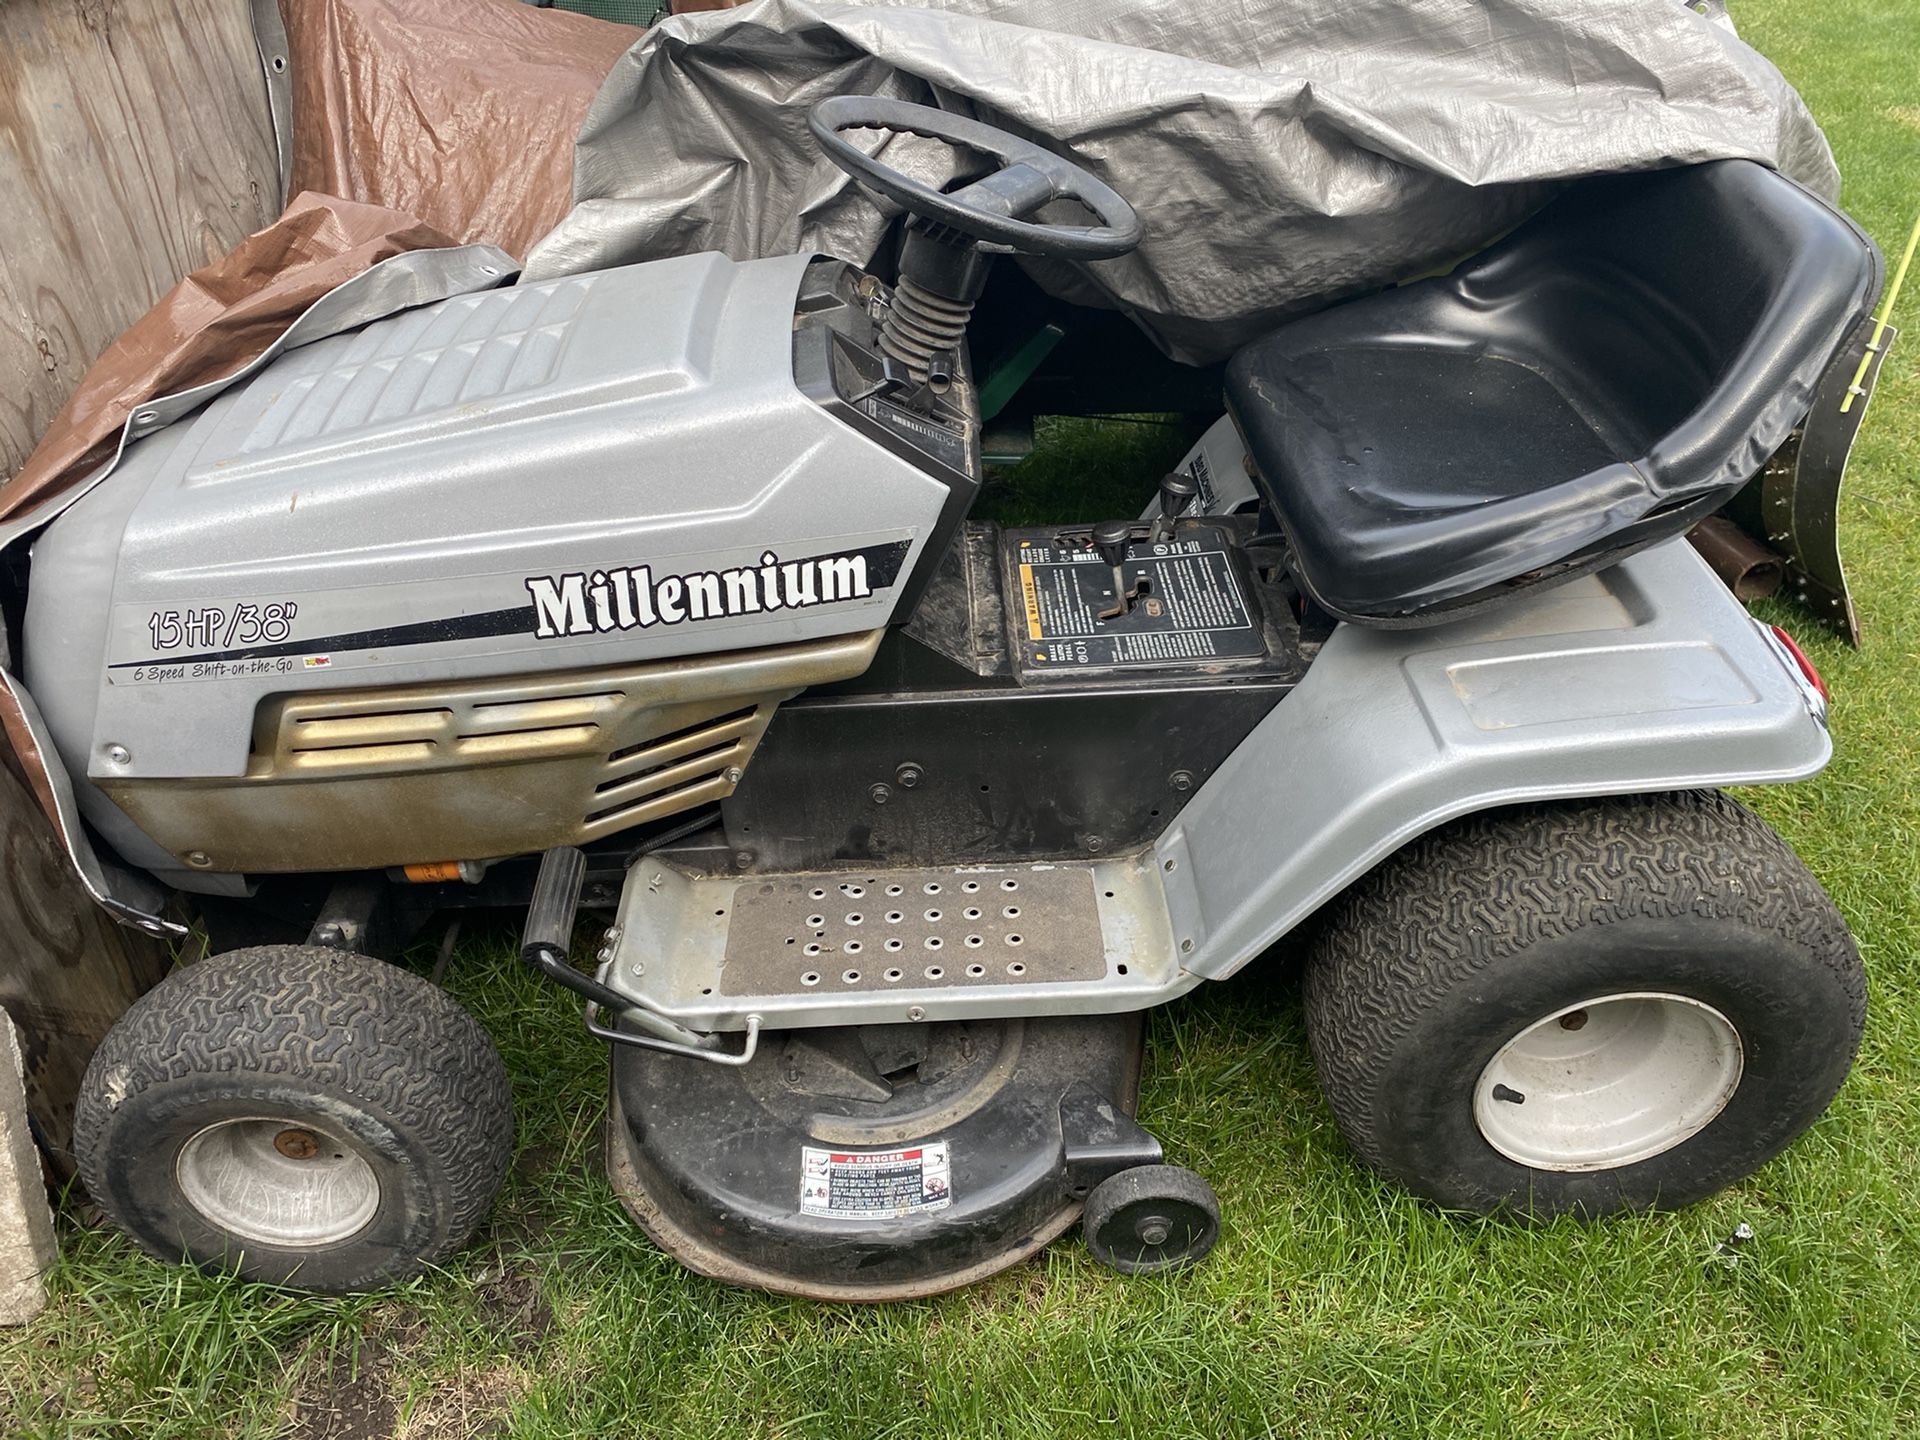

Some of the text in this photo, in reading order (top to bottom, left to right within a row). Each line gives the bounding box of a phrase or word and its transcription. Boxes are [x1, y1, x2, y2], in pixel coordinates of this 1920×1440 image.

[526, 550, 871, 639] Millennium
[1025, 582, 1037, 615] WARNING
[1049, 644, 1057, 662] BRAKE
[133, 667, 144, 681] 6
[147, 665, 184, 683] Speed
[192, 658, 293, 681] Shift-on-the-Go
[856, 1154, 904, 1163] DANGER
